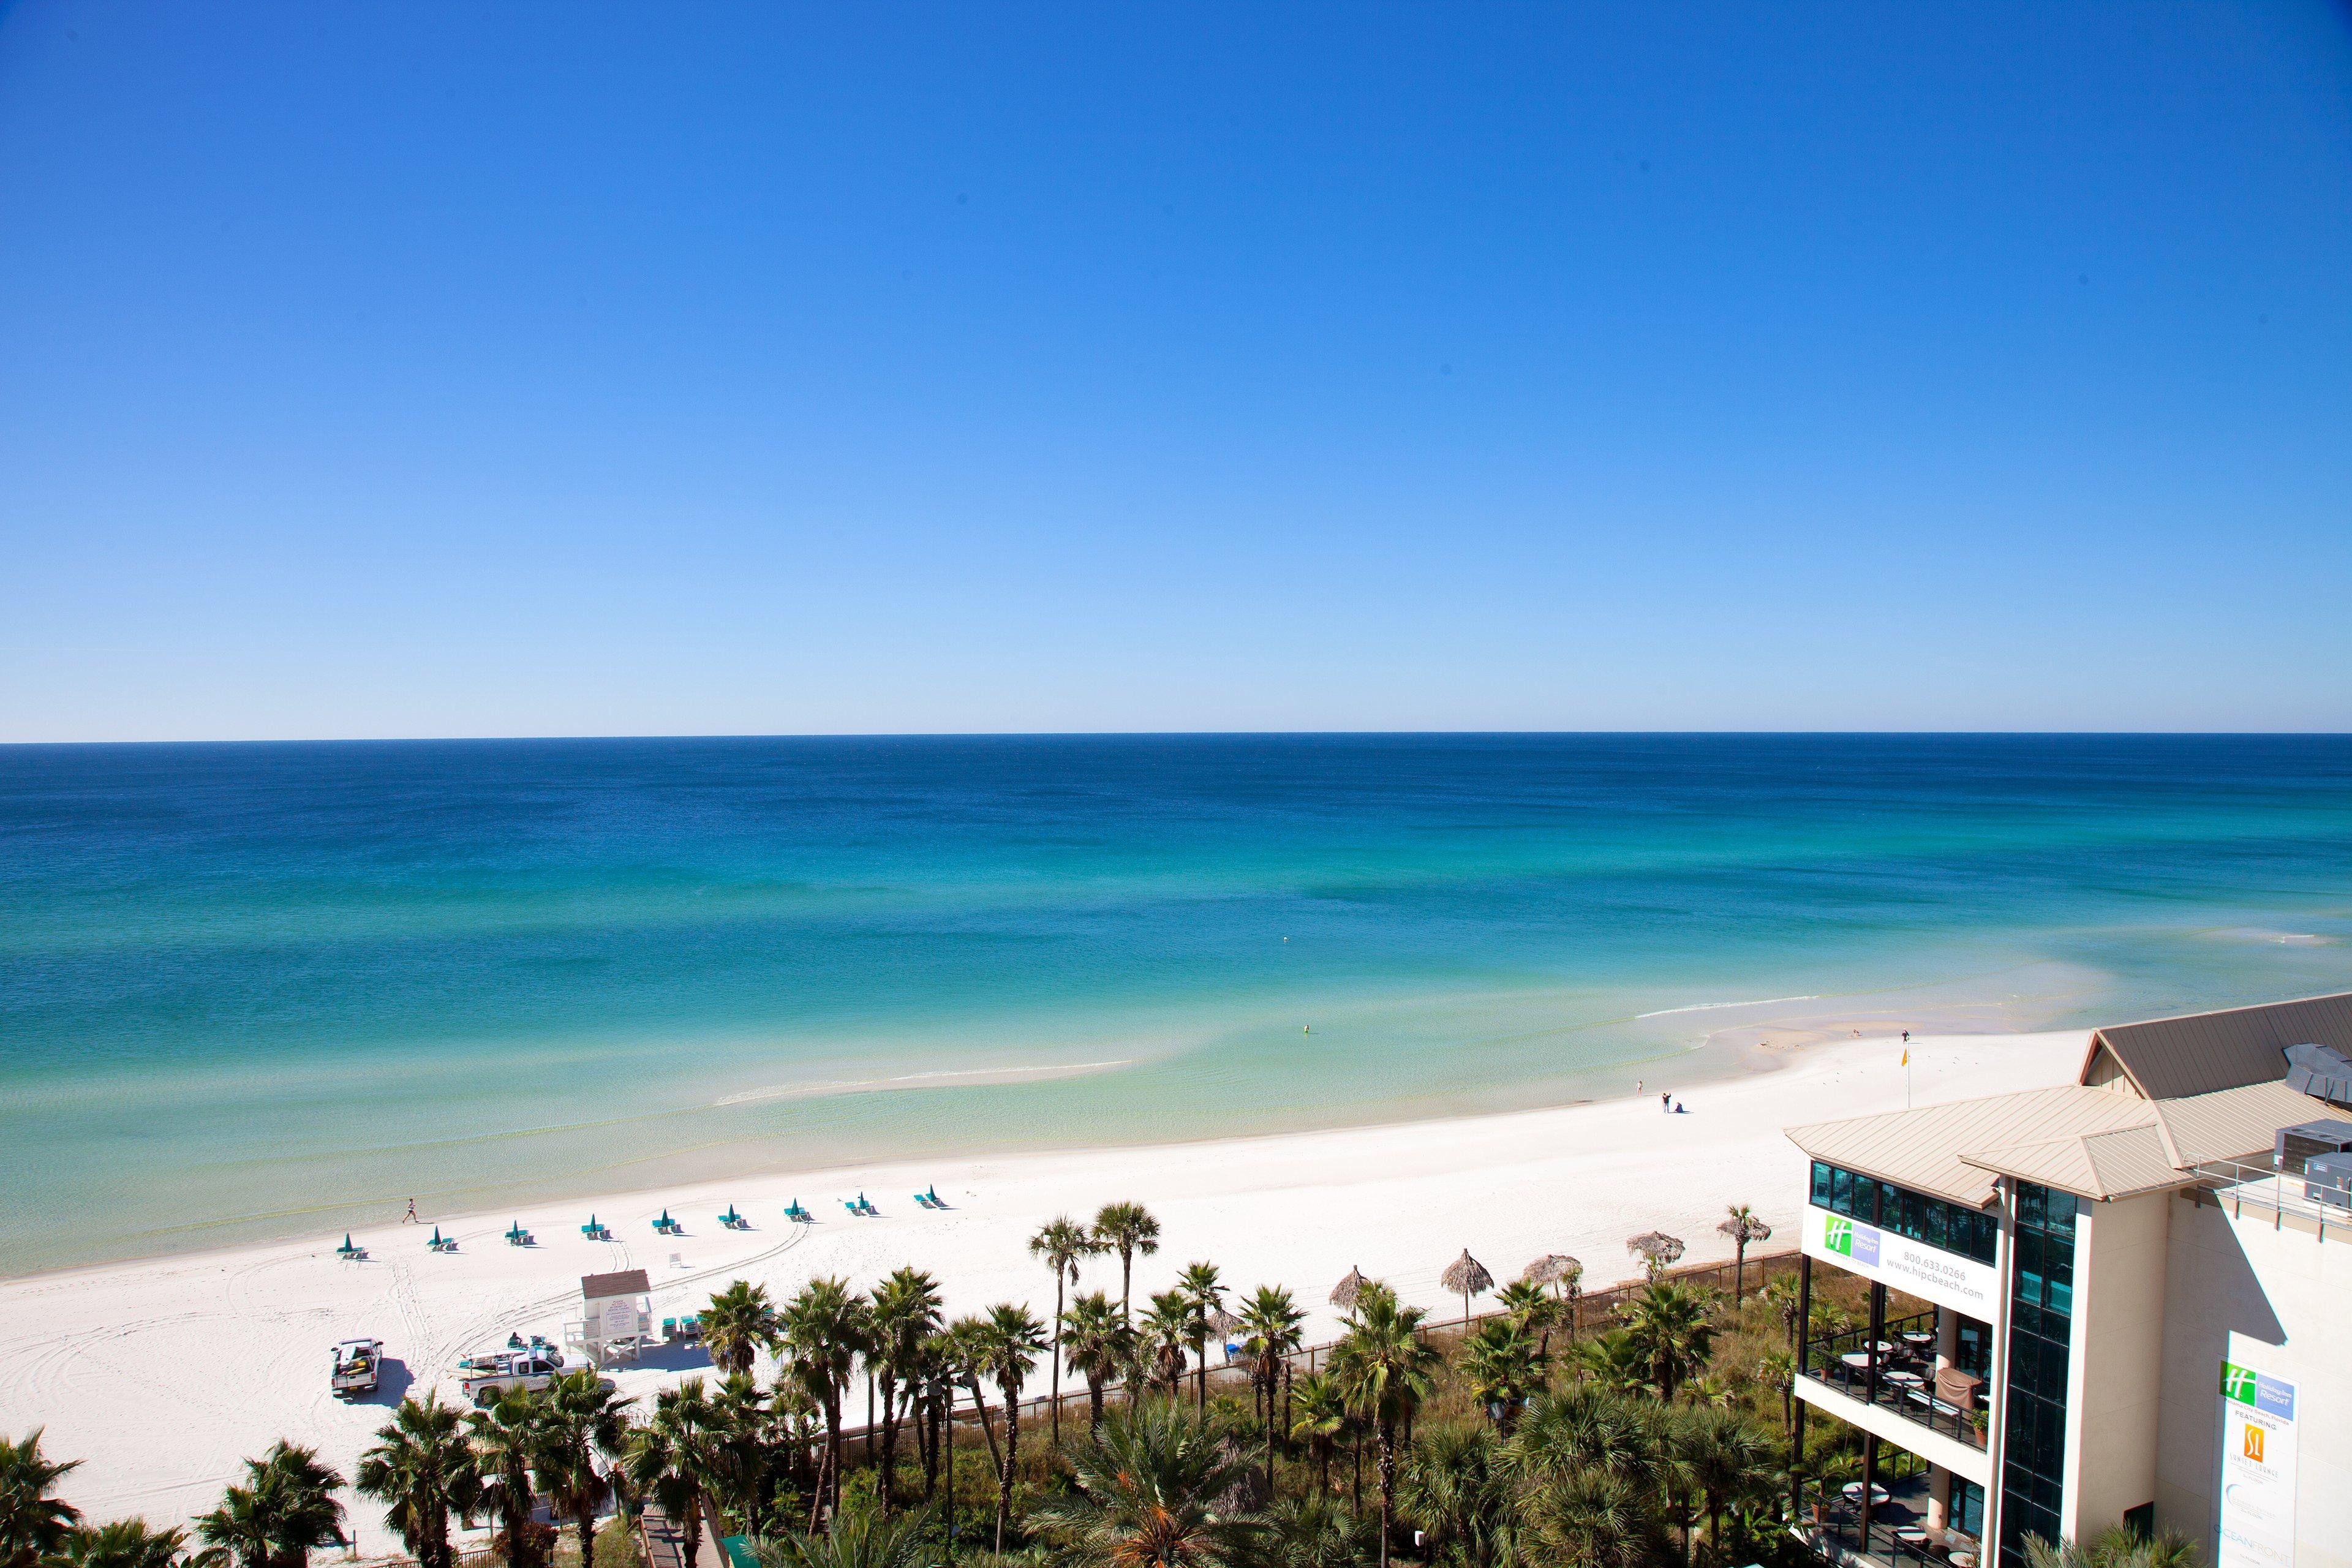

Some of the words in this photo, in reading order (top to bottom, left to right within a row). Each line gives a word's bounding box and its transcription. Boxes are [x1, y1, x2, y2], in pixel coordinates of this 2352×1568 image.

[1854, 1231, 1871, 1243] Holiday
[1855, 1238, 1877, 1253] Resort
[1904, 1251, 1966, 1281] 800.633.0266
[1887, 1259, 1983, 1300] www.hipcbeach.com
[2258, 1382, 2280, 1395] Holiday
[2260, 1389, 2290, 1406] Resort
[2225, 1397, 2243, 1409] Panama
[2272, 1415, 2289, 1425] Florida
[2236, 1411, 2277, 1431] FEATURING
[2214, 1524, 2291, 1564] OCEANFRONT
